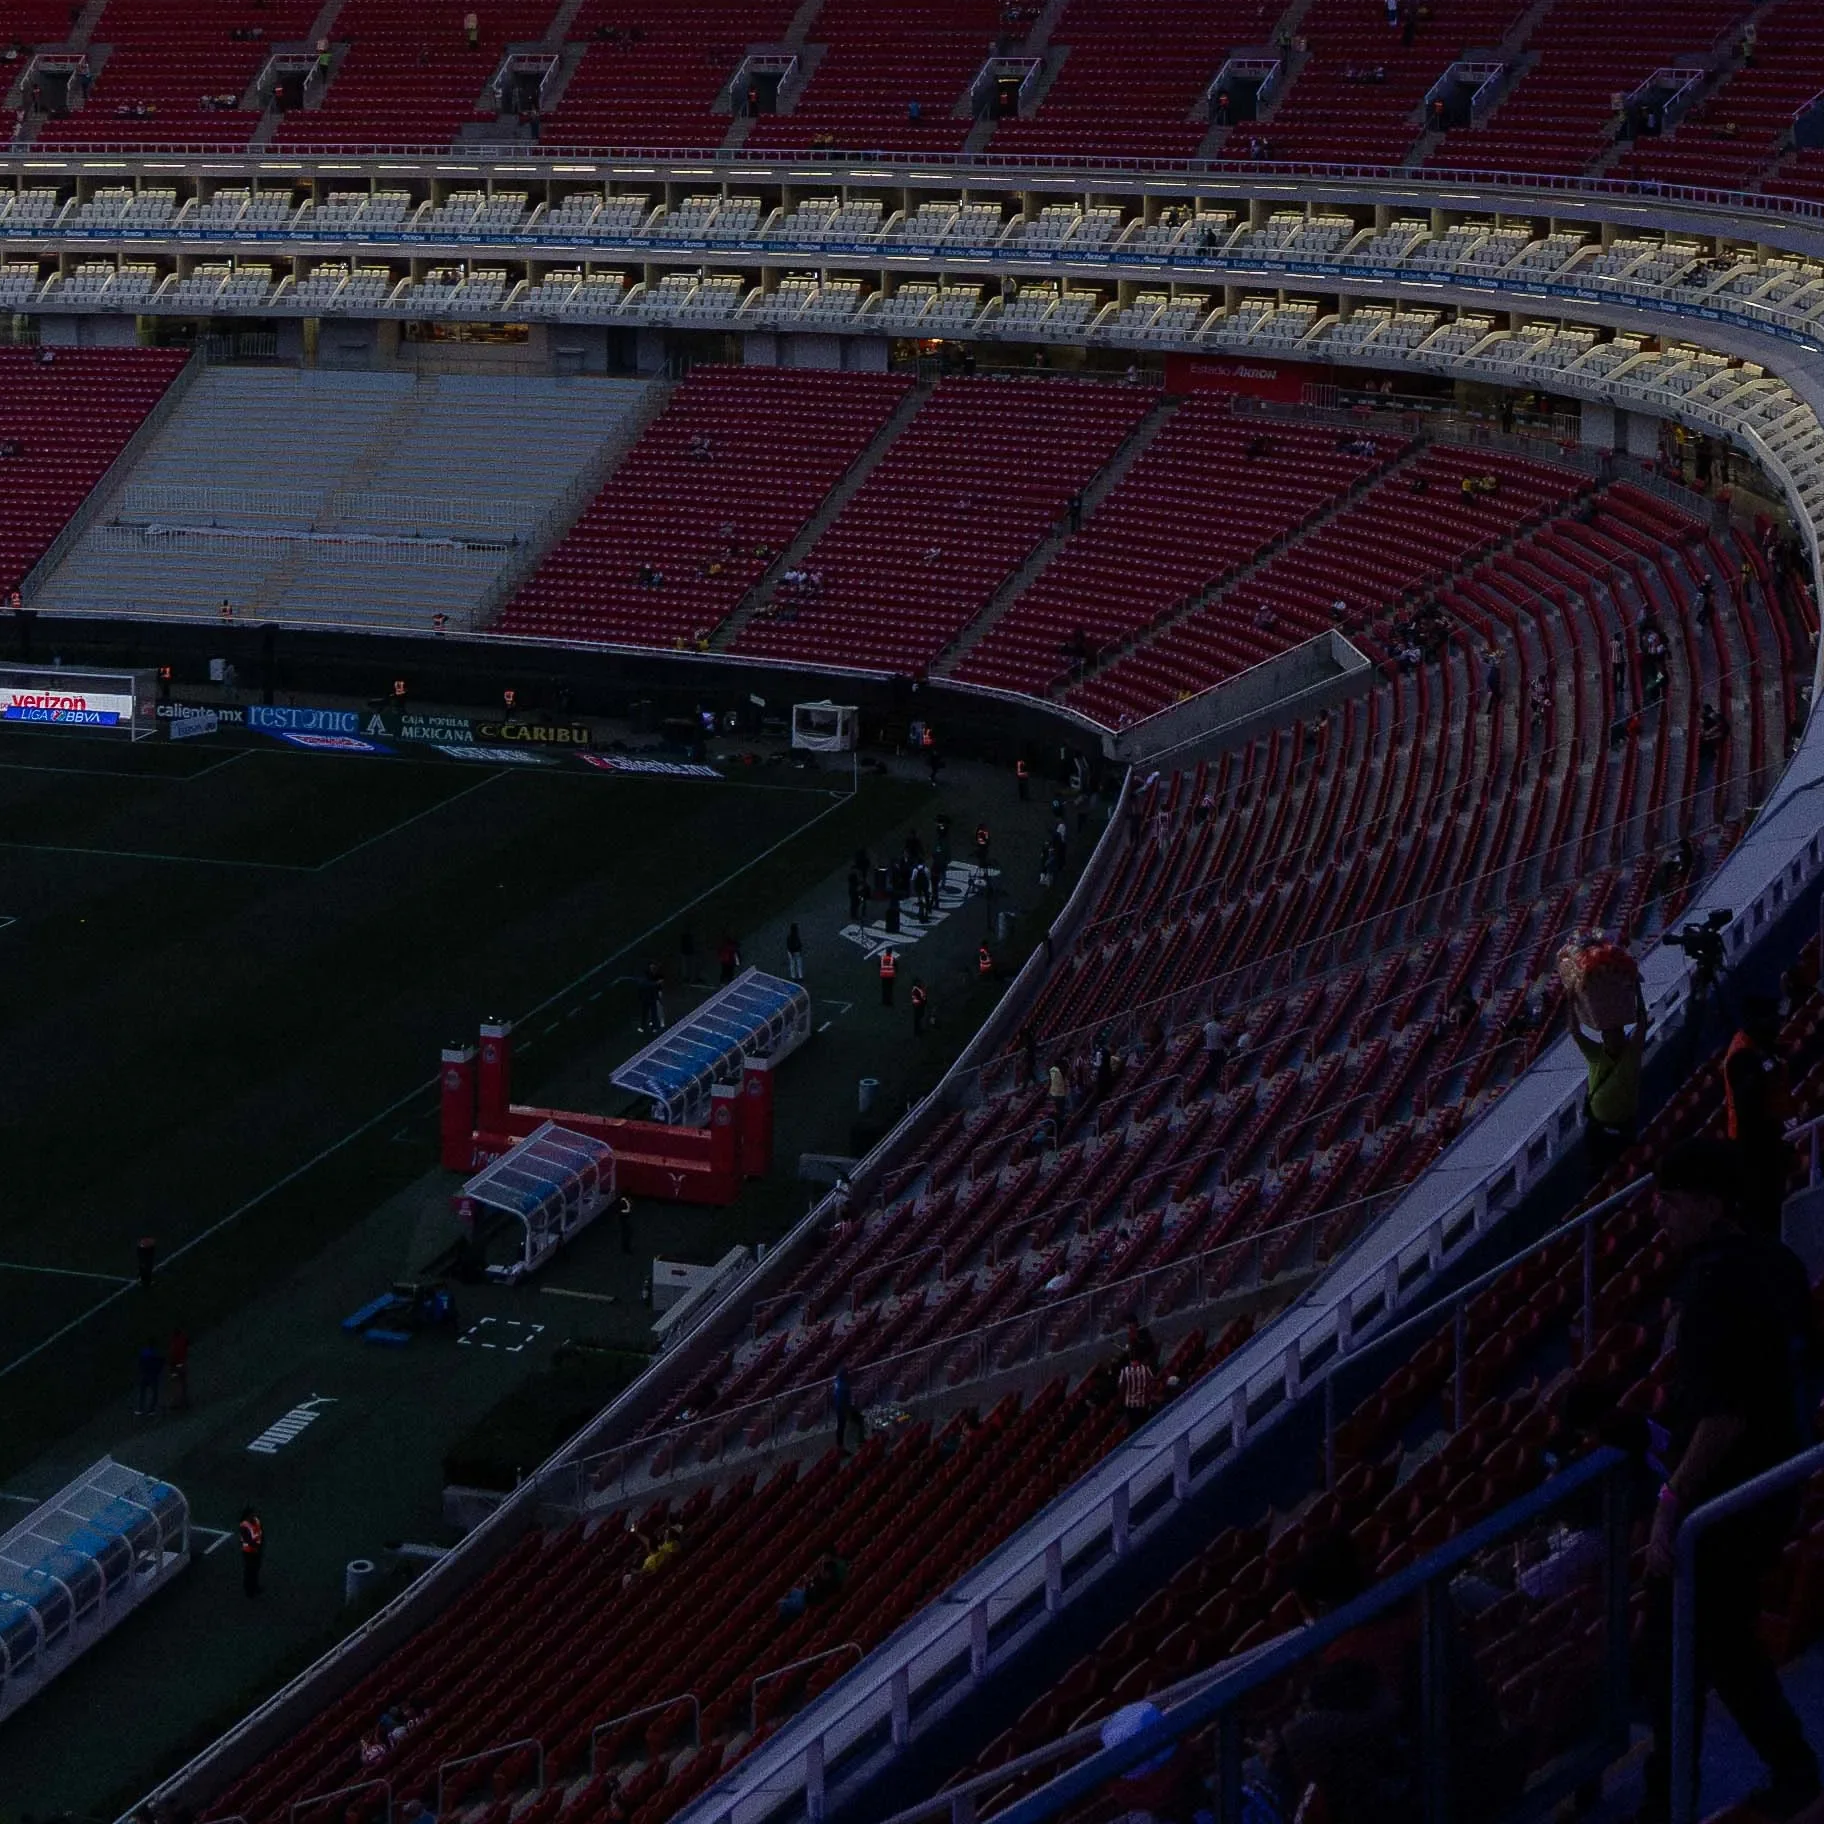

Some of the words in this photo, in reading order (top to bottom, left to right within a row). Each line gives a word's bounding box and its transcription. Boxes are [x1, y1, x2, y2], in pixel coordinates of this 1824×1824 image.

[11, 691, 87, 711] verizon
[21, 707, 49, 722] LIGA
[66, 710, 101, 724] BBVA
[401, 726, 473, 742] MEXICANA
